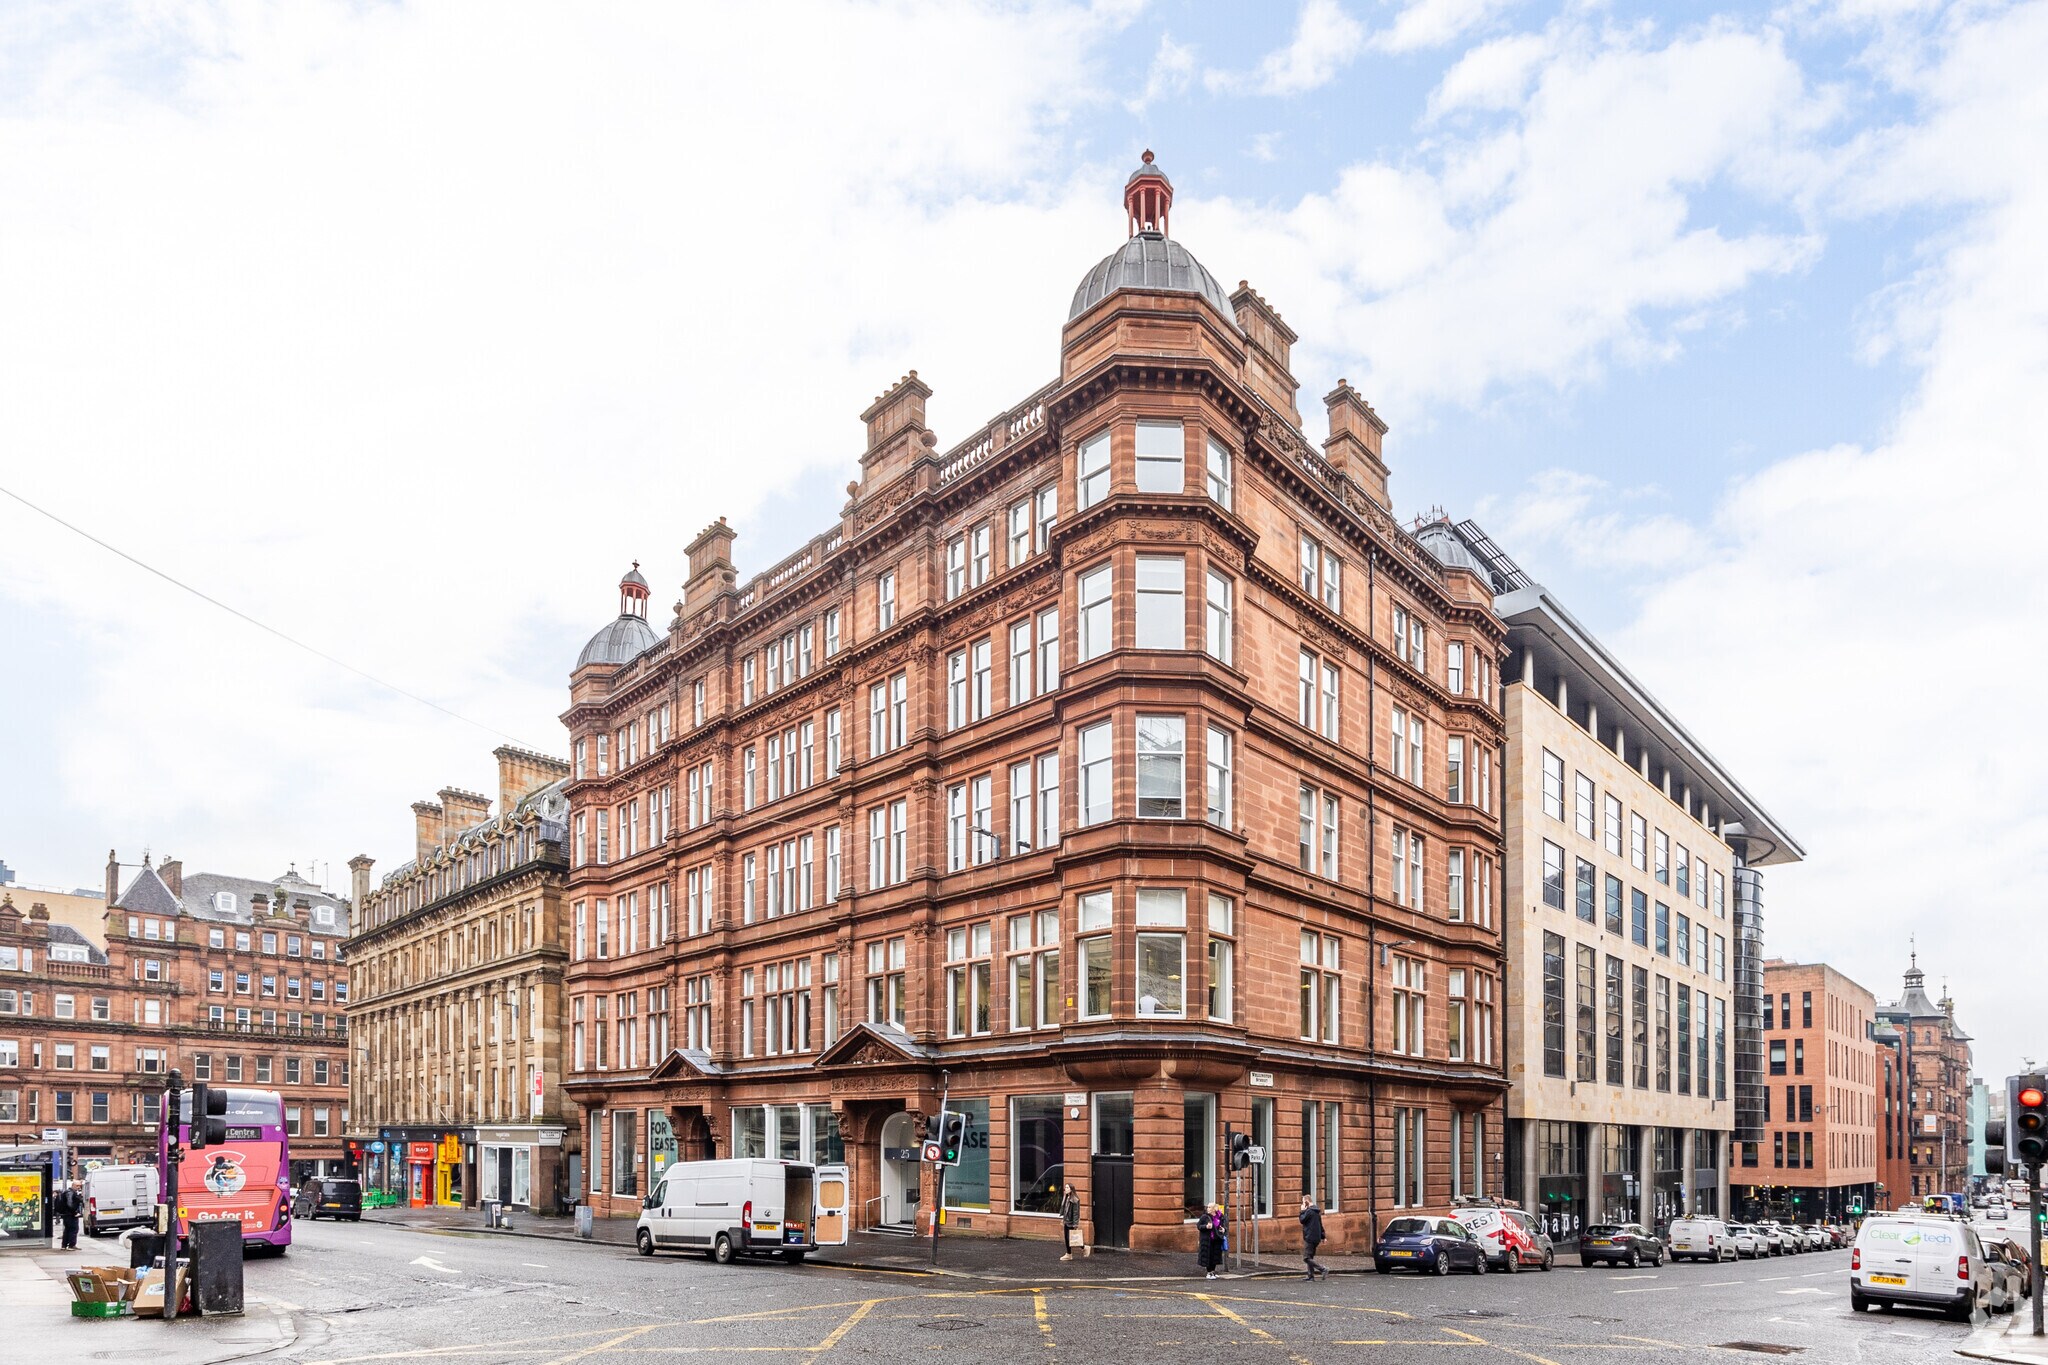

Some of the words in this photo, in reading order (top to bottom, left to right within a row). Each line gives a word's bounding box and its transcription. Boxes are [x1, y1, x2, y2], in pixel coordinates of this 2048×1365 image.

[230, 1128, 255, 1136] Centre
[650, 1122, 667, 1135] FOR
[650, 1138, 675, 1151] LEASE
[963, 1132, 988, 1149] ASE
[900, 1149, 910, 1159] 25
[198, 1211, 218, 1220] Go
[221, 1210, 241, 1220] for
[244, 1210, 255, 1220] it
[1465, 1212, 1494, 1231] REST
[1540, 1213, 1580, 1236] hape
[1870, 1229, 1901, 1240] Clear
[1923, 1232, 1952, 1243] tech
